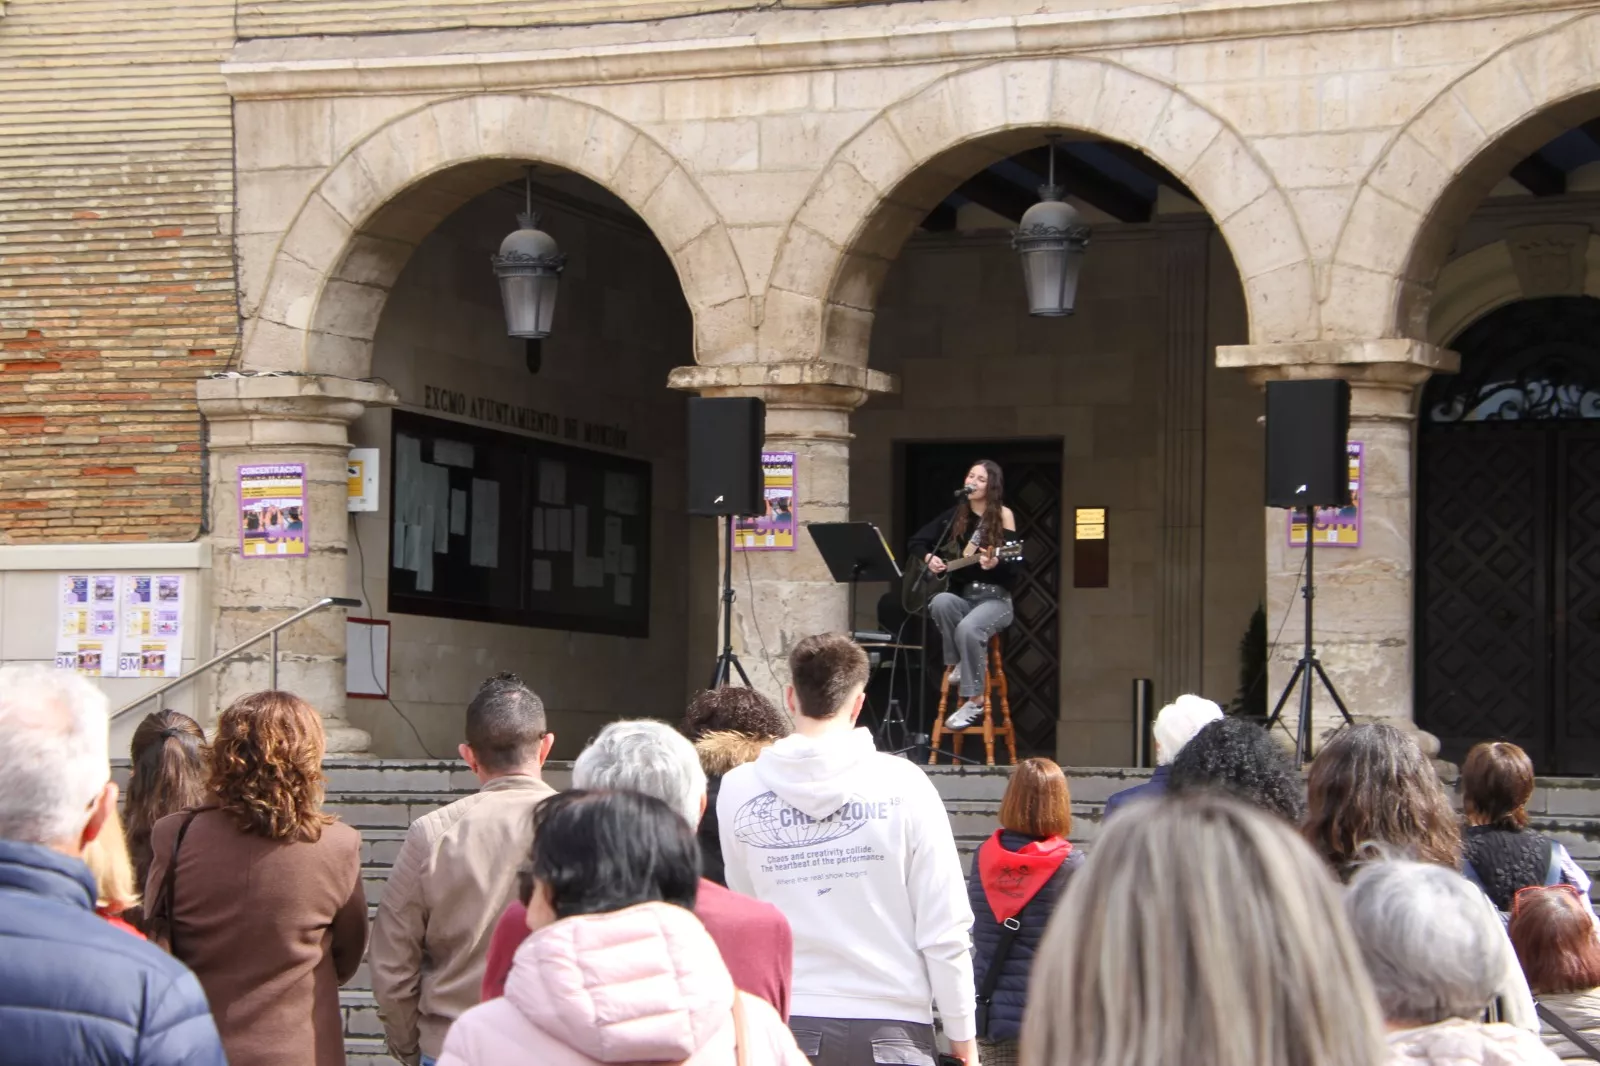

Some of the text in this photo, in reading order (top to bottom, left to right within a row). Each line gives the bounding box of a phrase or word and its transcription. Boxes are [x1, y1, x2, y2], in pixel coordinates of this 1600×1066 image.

[425, 385, 465, 415] EXCMO
[470, 397, 558, 436] AYUNTAMIENTO
[564, 417, 577, 440] DE
[56, 657, 77, 670] 8M
[119, 657, 140, 671] 8M
[760, 854, 885, 873] The heartbeat of the performance
[767, 855, 789, 864] Chaos
[790, 852, 805, 860] and
[806, 848, 844, 859] creativity
[825, 872, 843, 880] show
